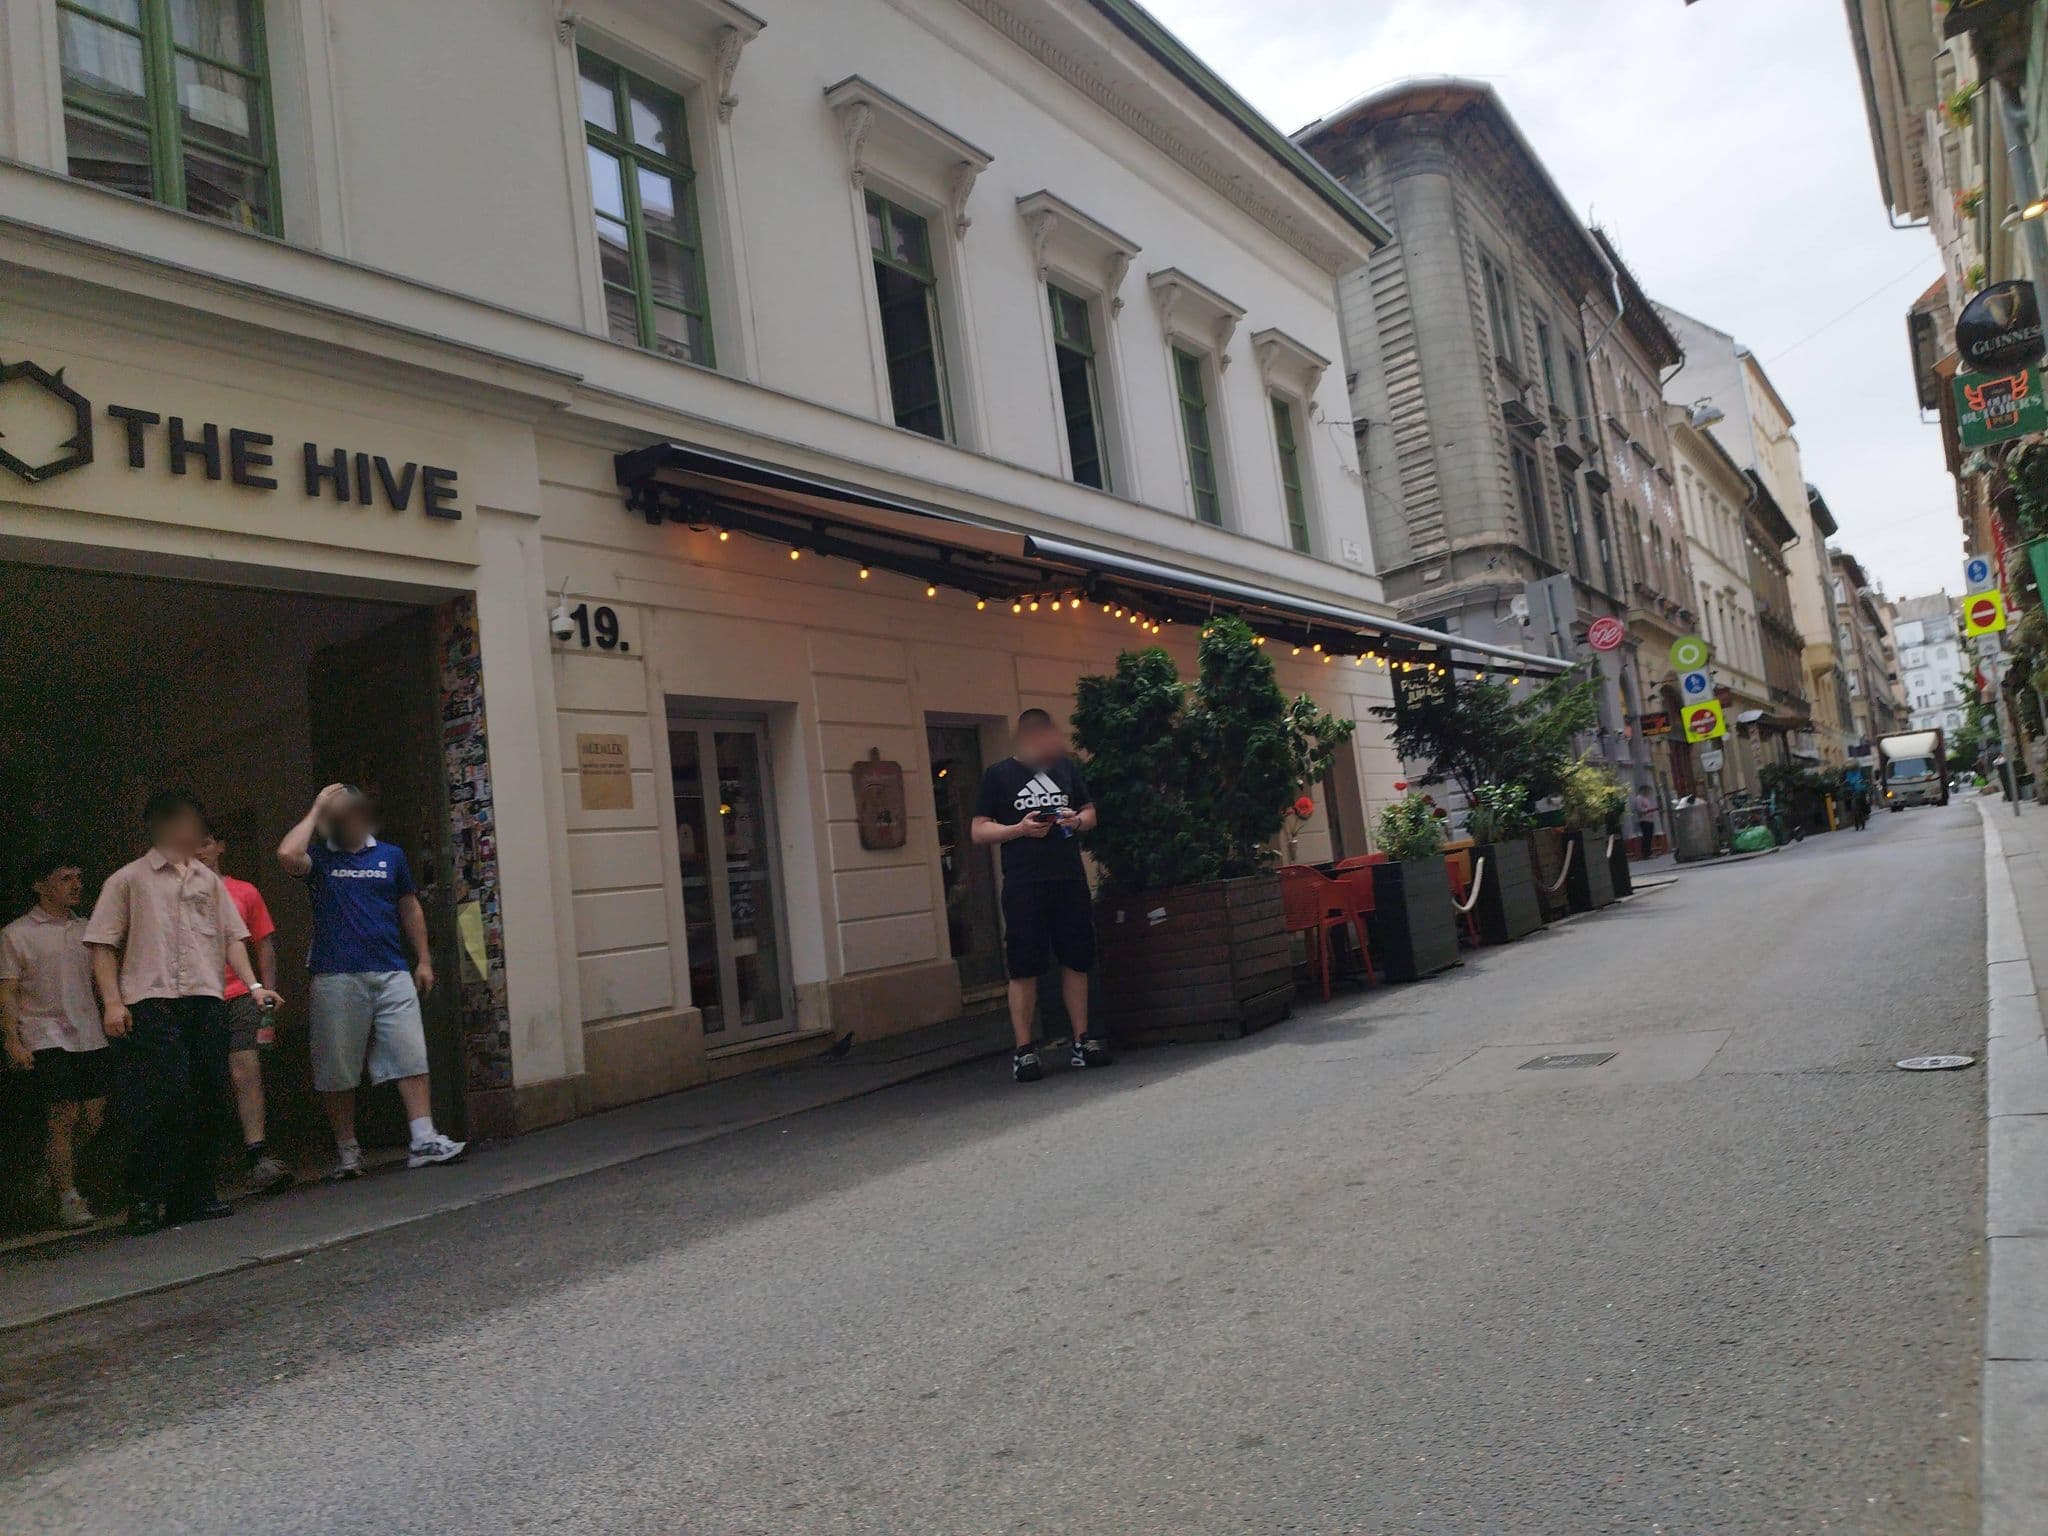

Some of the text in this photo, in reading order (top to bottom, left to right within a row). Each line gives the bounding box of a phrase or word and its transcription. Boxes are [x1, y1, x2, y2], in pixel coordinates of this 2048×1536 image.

[108, 404, 462, 521] THE HIVE
[570, 603, 629, 652] 19.
[1013, 793, 1069, 811] adidas
